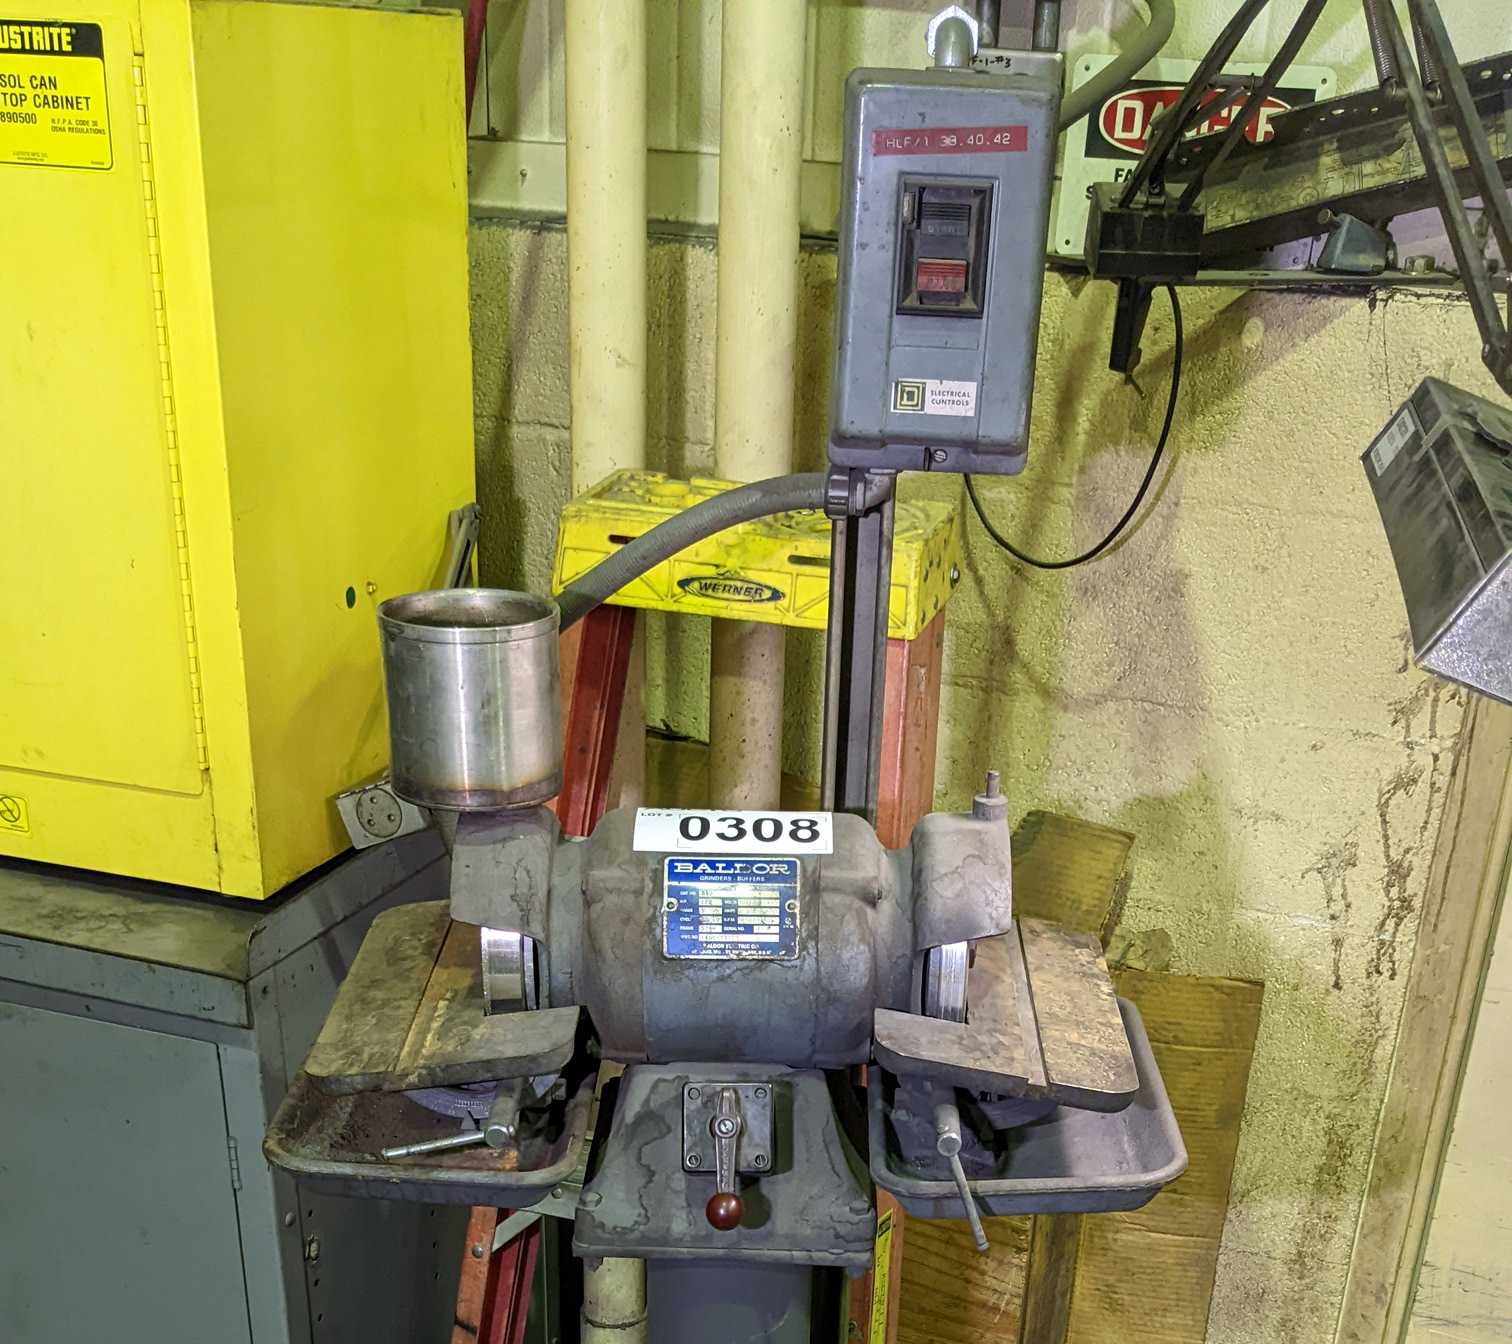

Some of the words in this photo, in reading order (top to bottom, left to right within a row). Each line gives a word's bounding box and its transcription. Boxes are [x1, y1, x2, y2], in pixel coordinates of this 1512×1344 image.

[30, 75, 57, 90] CAN
[1, 92, 28, 107] TOP
[33, 93, 91, 111] CABINET
[930, 390, 971, 398] ELECTRICAL
[931, 398, 969, 406] CONTROLS
[700, 581, 764, 597] WERNER
[679, 816, 820, 843] 0308
[673, 863, 790, 875] BALDOR
